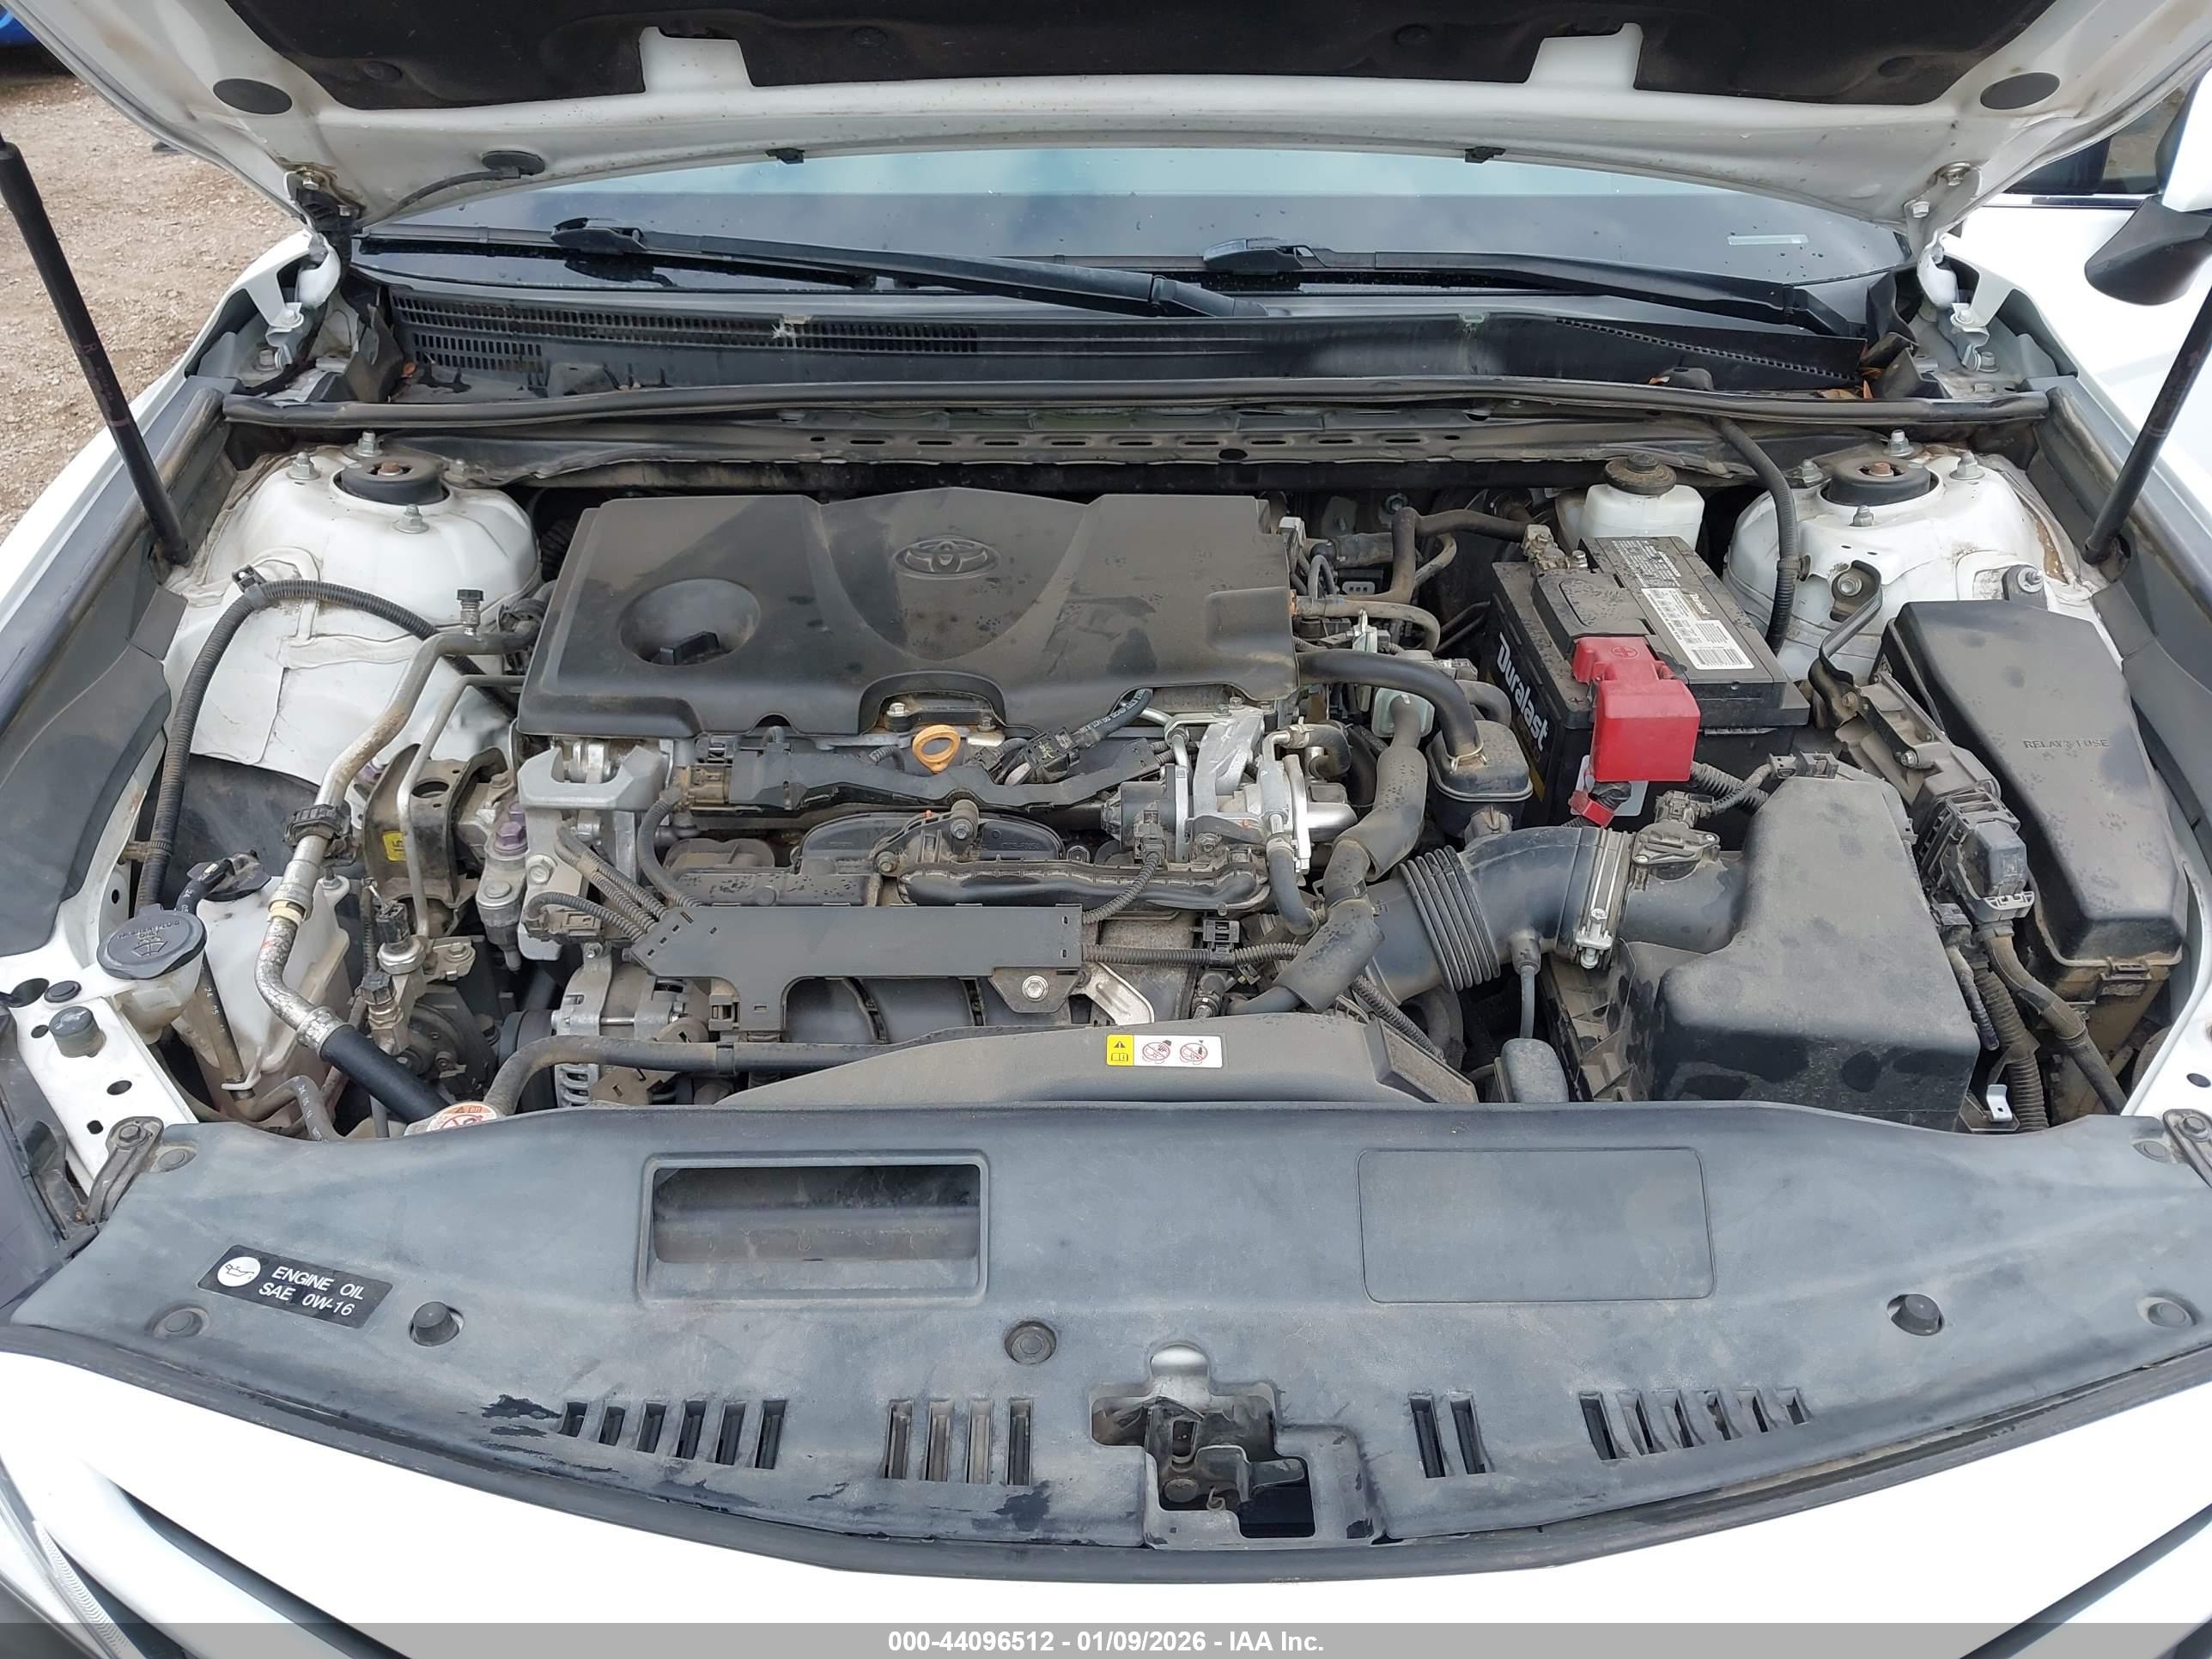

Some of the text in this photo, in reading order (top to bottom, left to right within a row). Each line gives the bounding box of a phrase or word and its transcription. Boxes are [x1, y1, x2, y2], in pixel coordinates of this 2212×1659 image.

[1497, 631, 1548, 752] Duralast
[258, 1282, 356, 1316] SAE 0W-16
[271, 1266, 365, 1300] ENGINE OIL
